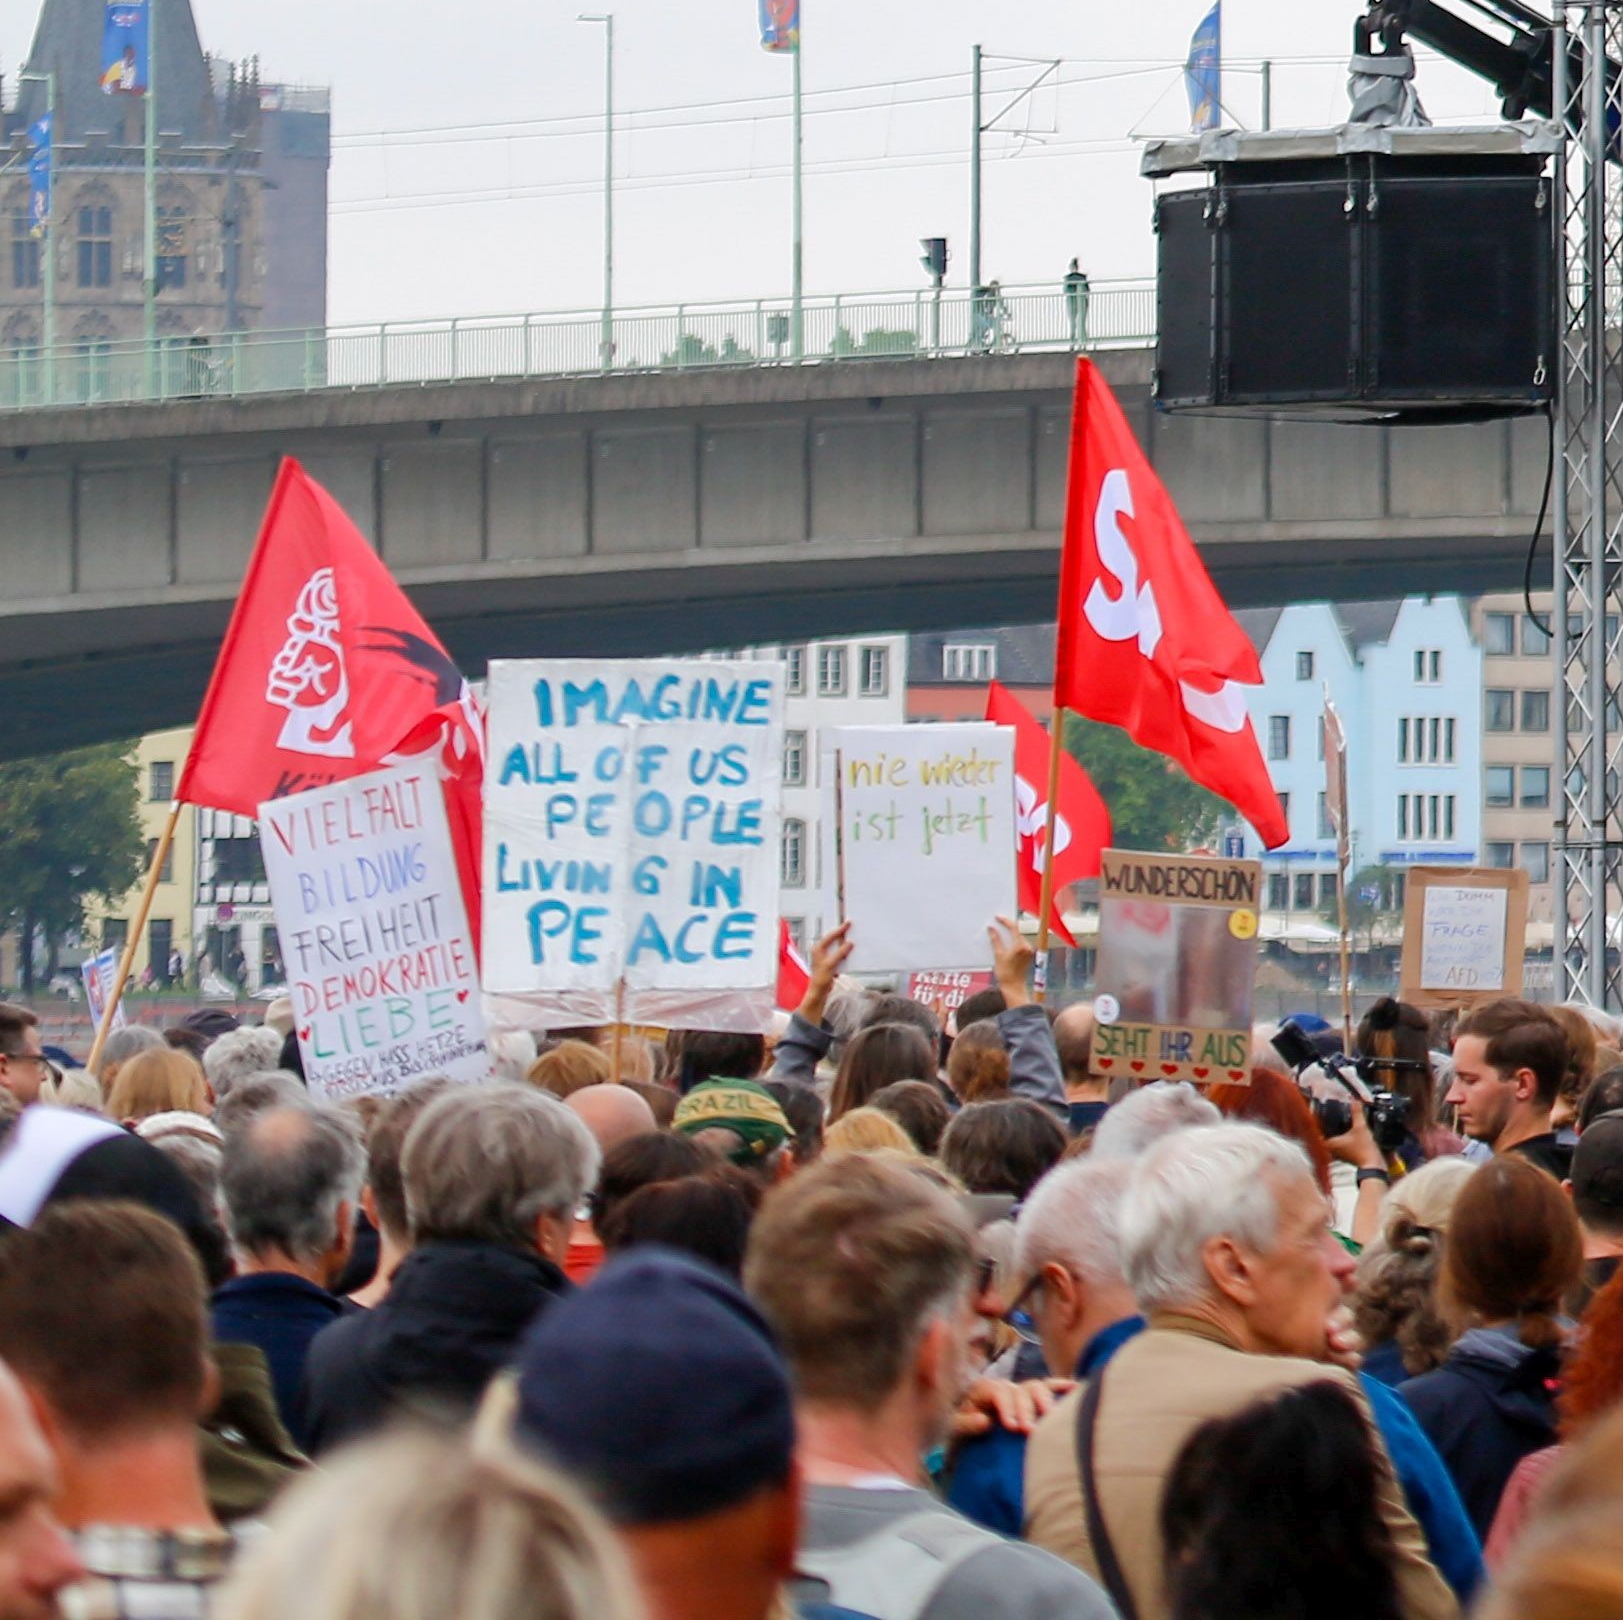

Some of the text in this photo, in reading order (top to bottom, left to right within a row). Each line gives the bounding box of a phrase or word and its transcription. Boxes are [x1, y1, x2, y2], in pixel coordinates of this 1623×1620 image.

[533, 673, 772, 728] IMAGINE
[497, 742, 749, 787] ALL OF US
[848, 747, 1003, 789] nie wieder
[269, 776, 423, 857] VIELFALT
[545, 790, 765, 845] PEOPLE
[853, 795, 993, 857] ist jetzt
[297, 842, 427, 915] BILDUNG
[689, 860, 743, 909] IN
[1102, 863, 1256, 903] WUNDERSCHÖN
[290, 892, 441, 973] FREIHEIT
[525, 899, 758, 966] PEACE
[295, 937, 470, 1018] DEMOKRATIE
[310, 987, 457, 1059] LIEBE
[1094, 1024, 1248, 1068] SEHT IHR AUS
